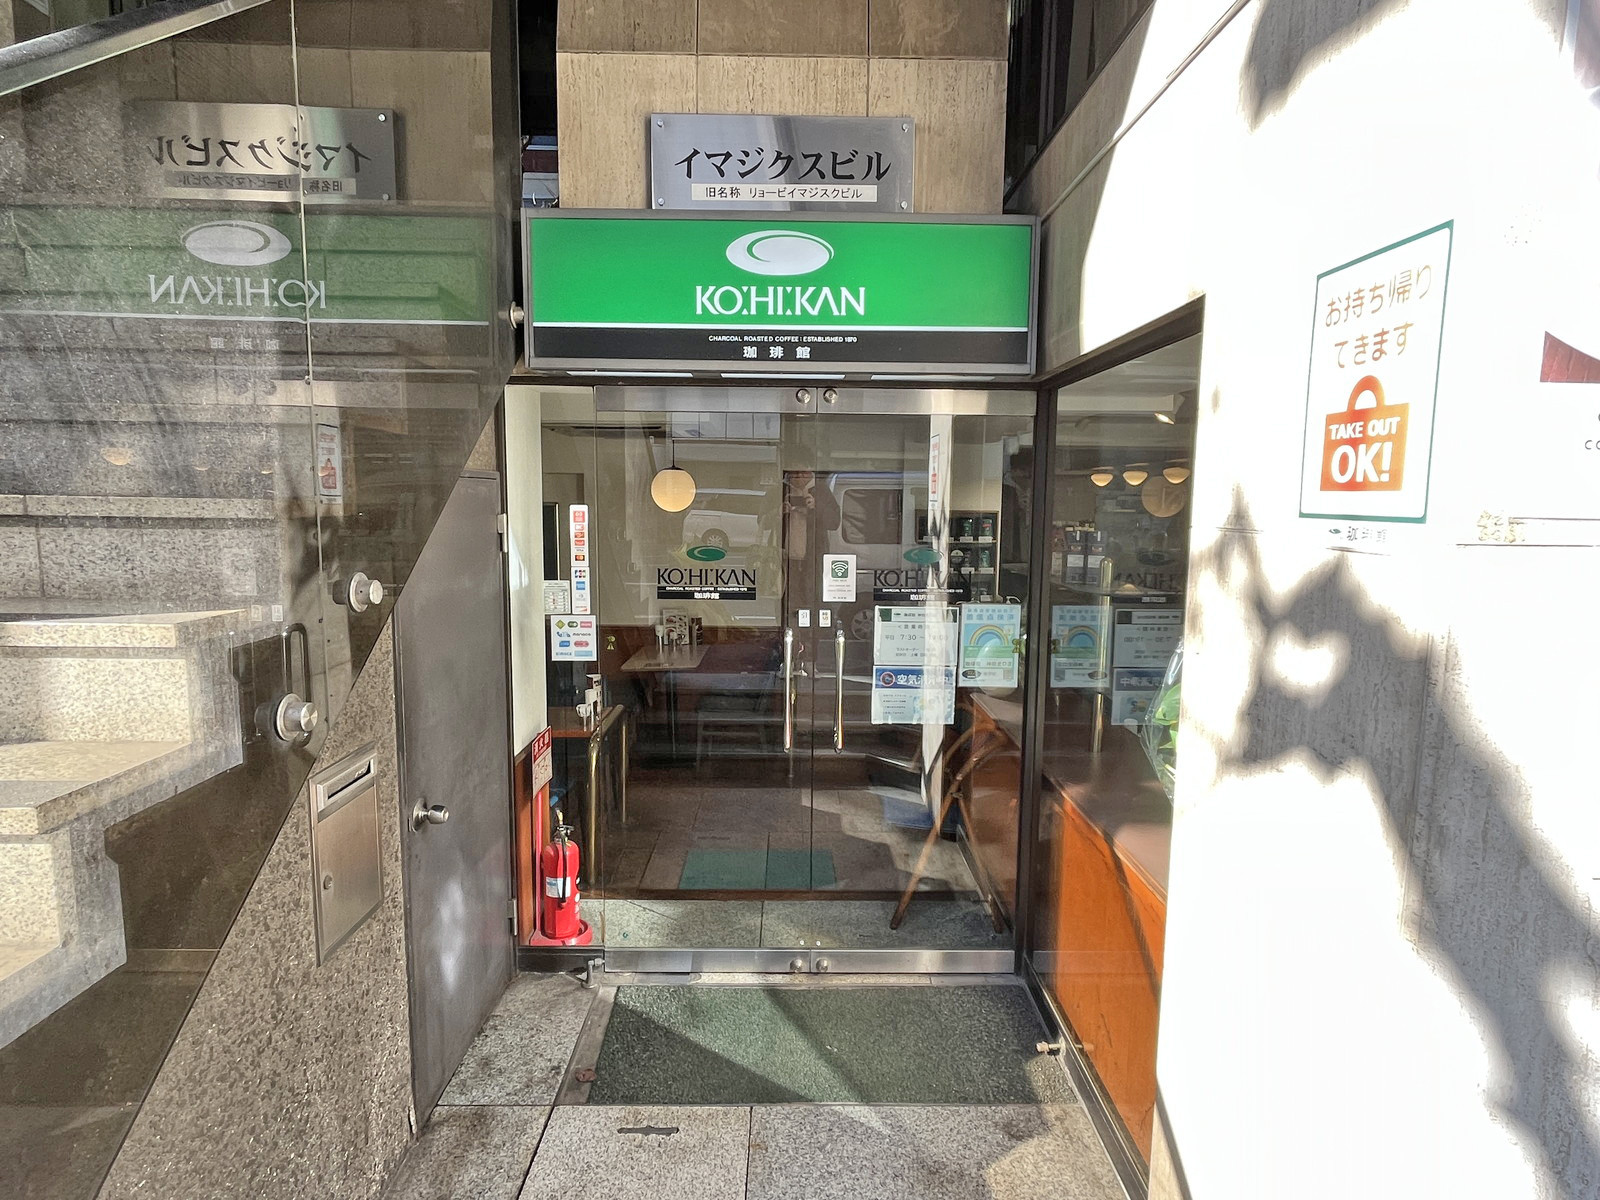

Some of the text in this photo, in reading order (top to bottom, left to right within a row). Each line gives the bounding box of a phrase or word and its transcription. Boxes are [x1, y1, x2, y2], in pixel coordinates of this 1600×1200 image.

[674, 146, 892, 181] イマジクスビル
[705, 186, 863, 200] 旧名称 リョービイマジスクビル
[1325, 264, 1432, 327] お持ち帰り
[743, 345, 811, 359] 珈琲館
[1328, 416, 1400, 440] TAKE OUT
[1330, 441, 1394, 483] OK!
